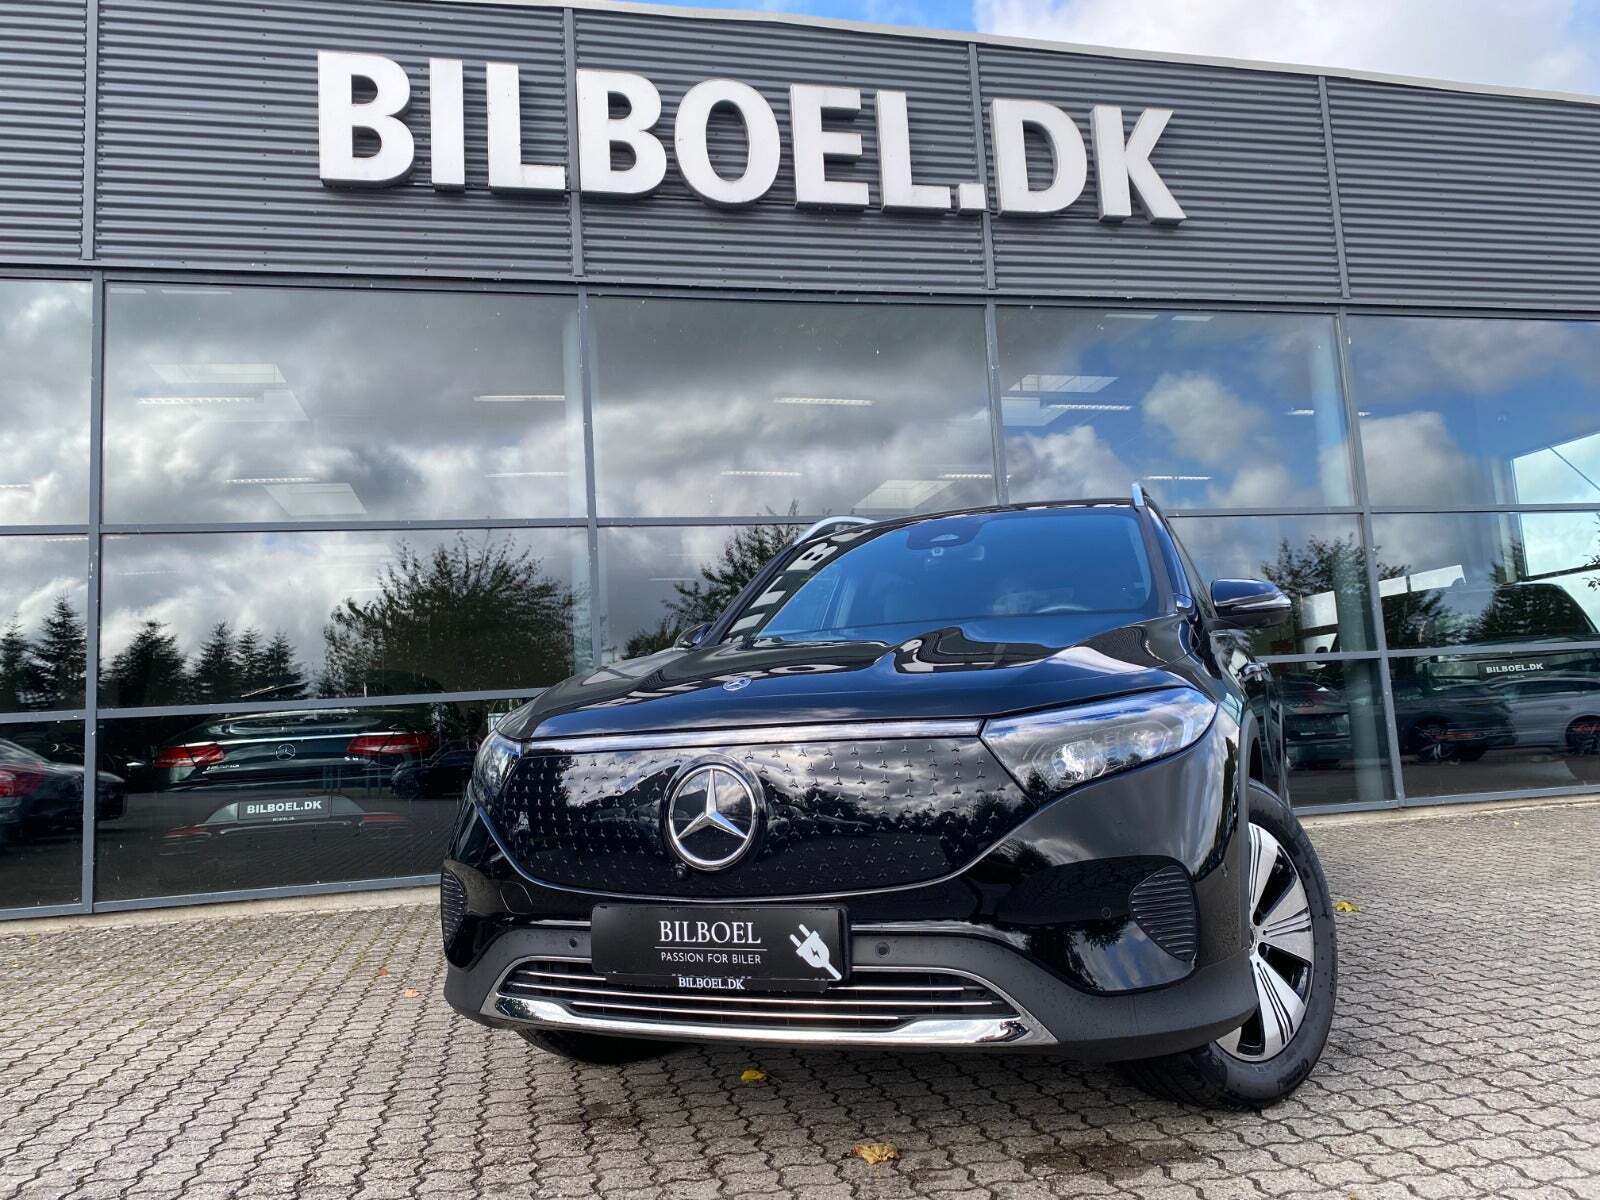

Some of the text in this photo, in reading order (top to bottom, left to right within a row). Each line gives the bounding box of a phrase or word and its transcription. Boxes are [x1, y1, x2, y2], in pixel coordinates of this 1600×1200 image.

[316, 51, 1187, 225] BILBOEL.DK
[1486, 663, 1544, 673] BILBOEL.DK
[247, 800, 322, 814] BILBOEL.DK
[659, 920, 761, 943] BILBOEL
[661, 952, 761, 964] PASSION FOR BILER
[678, 977, 745, 989] BILBOEL.DK
